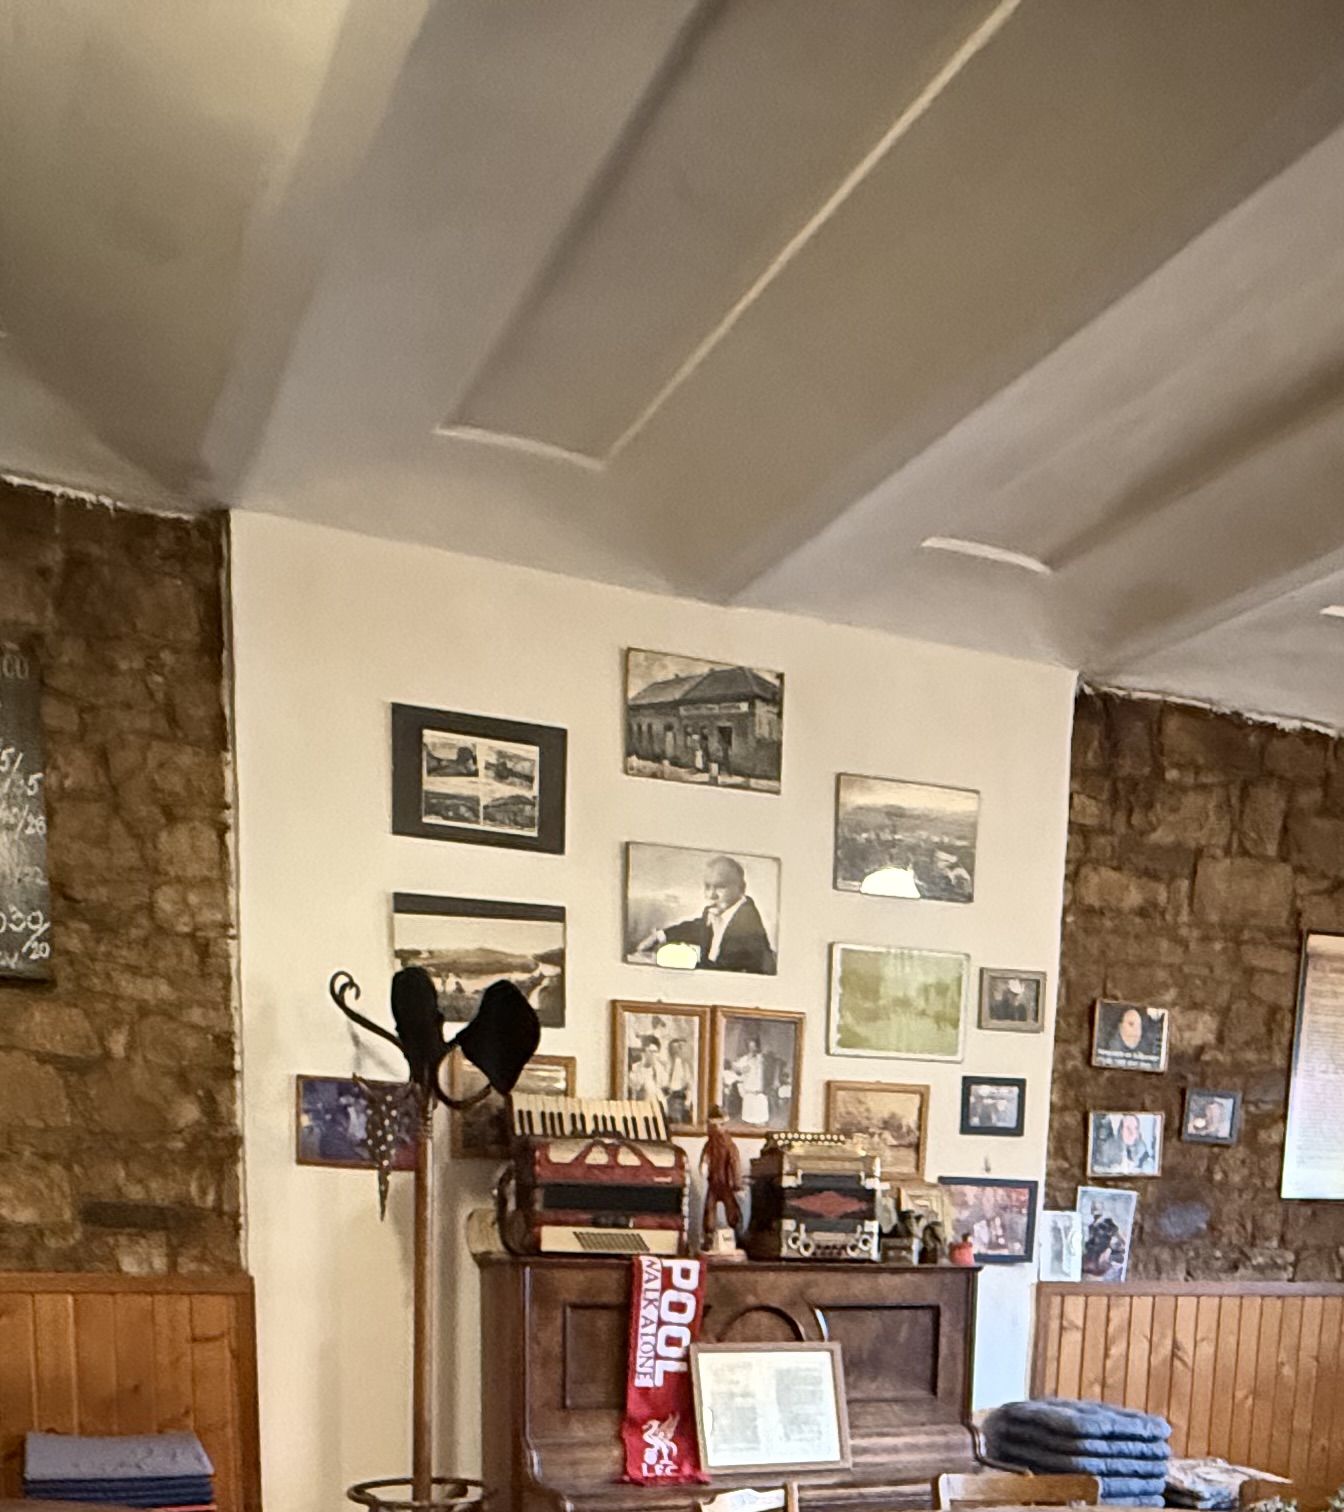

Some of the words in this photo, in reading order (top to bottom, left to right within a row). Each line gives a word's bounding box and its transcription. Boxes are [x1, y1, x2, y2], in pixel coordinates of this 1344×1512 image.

[636, 1318, 657, 1383] ALONE
[654, 1258, 701, 1389] POOL
[640, 1462, 679, 1477] LFC
